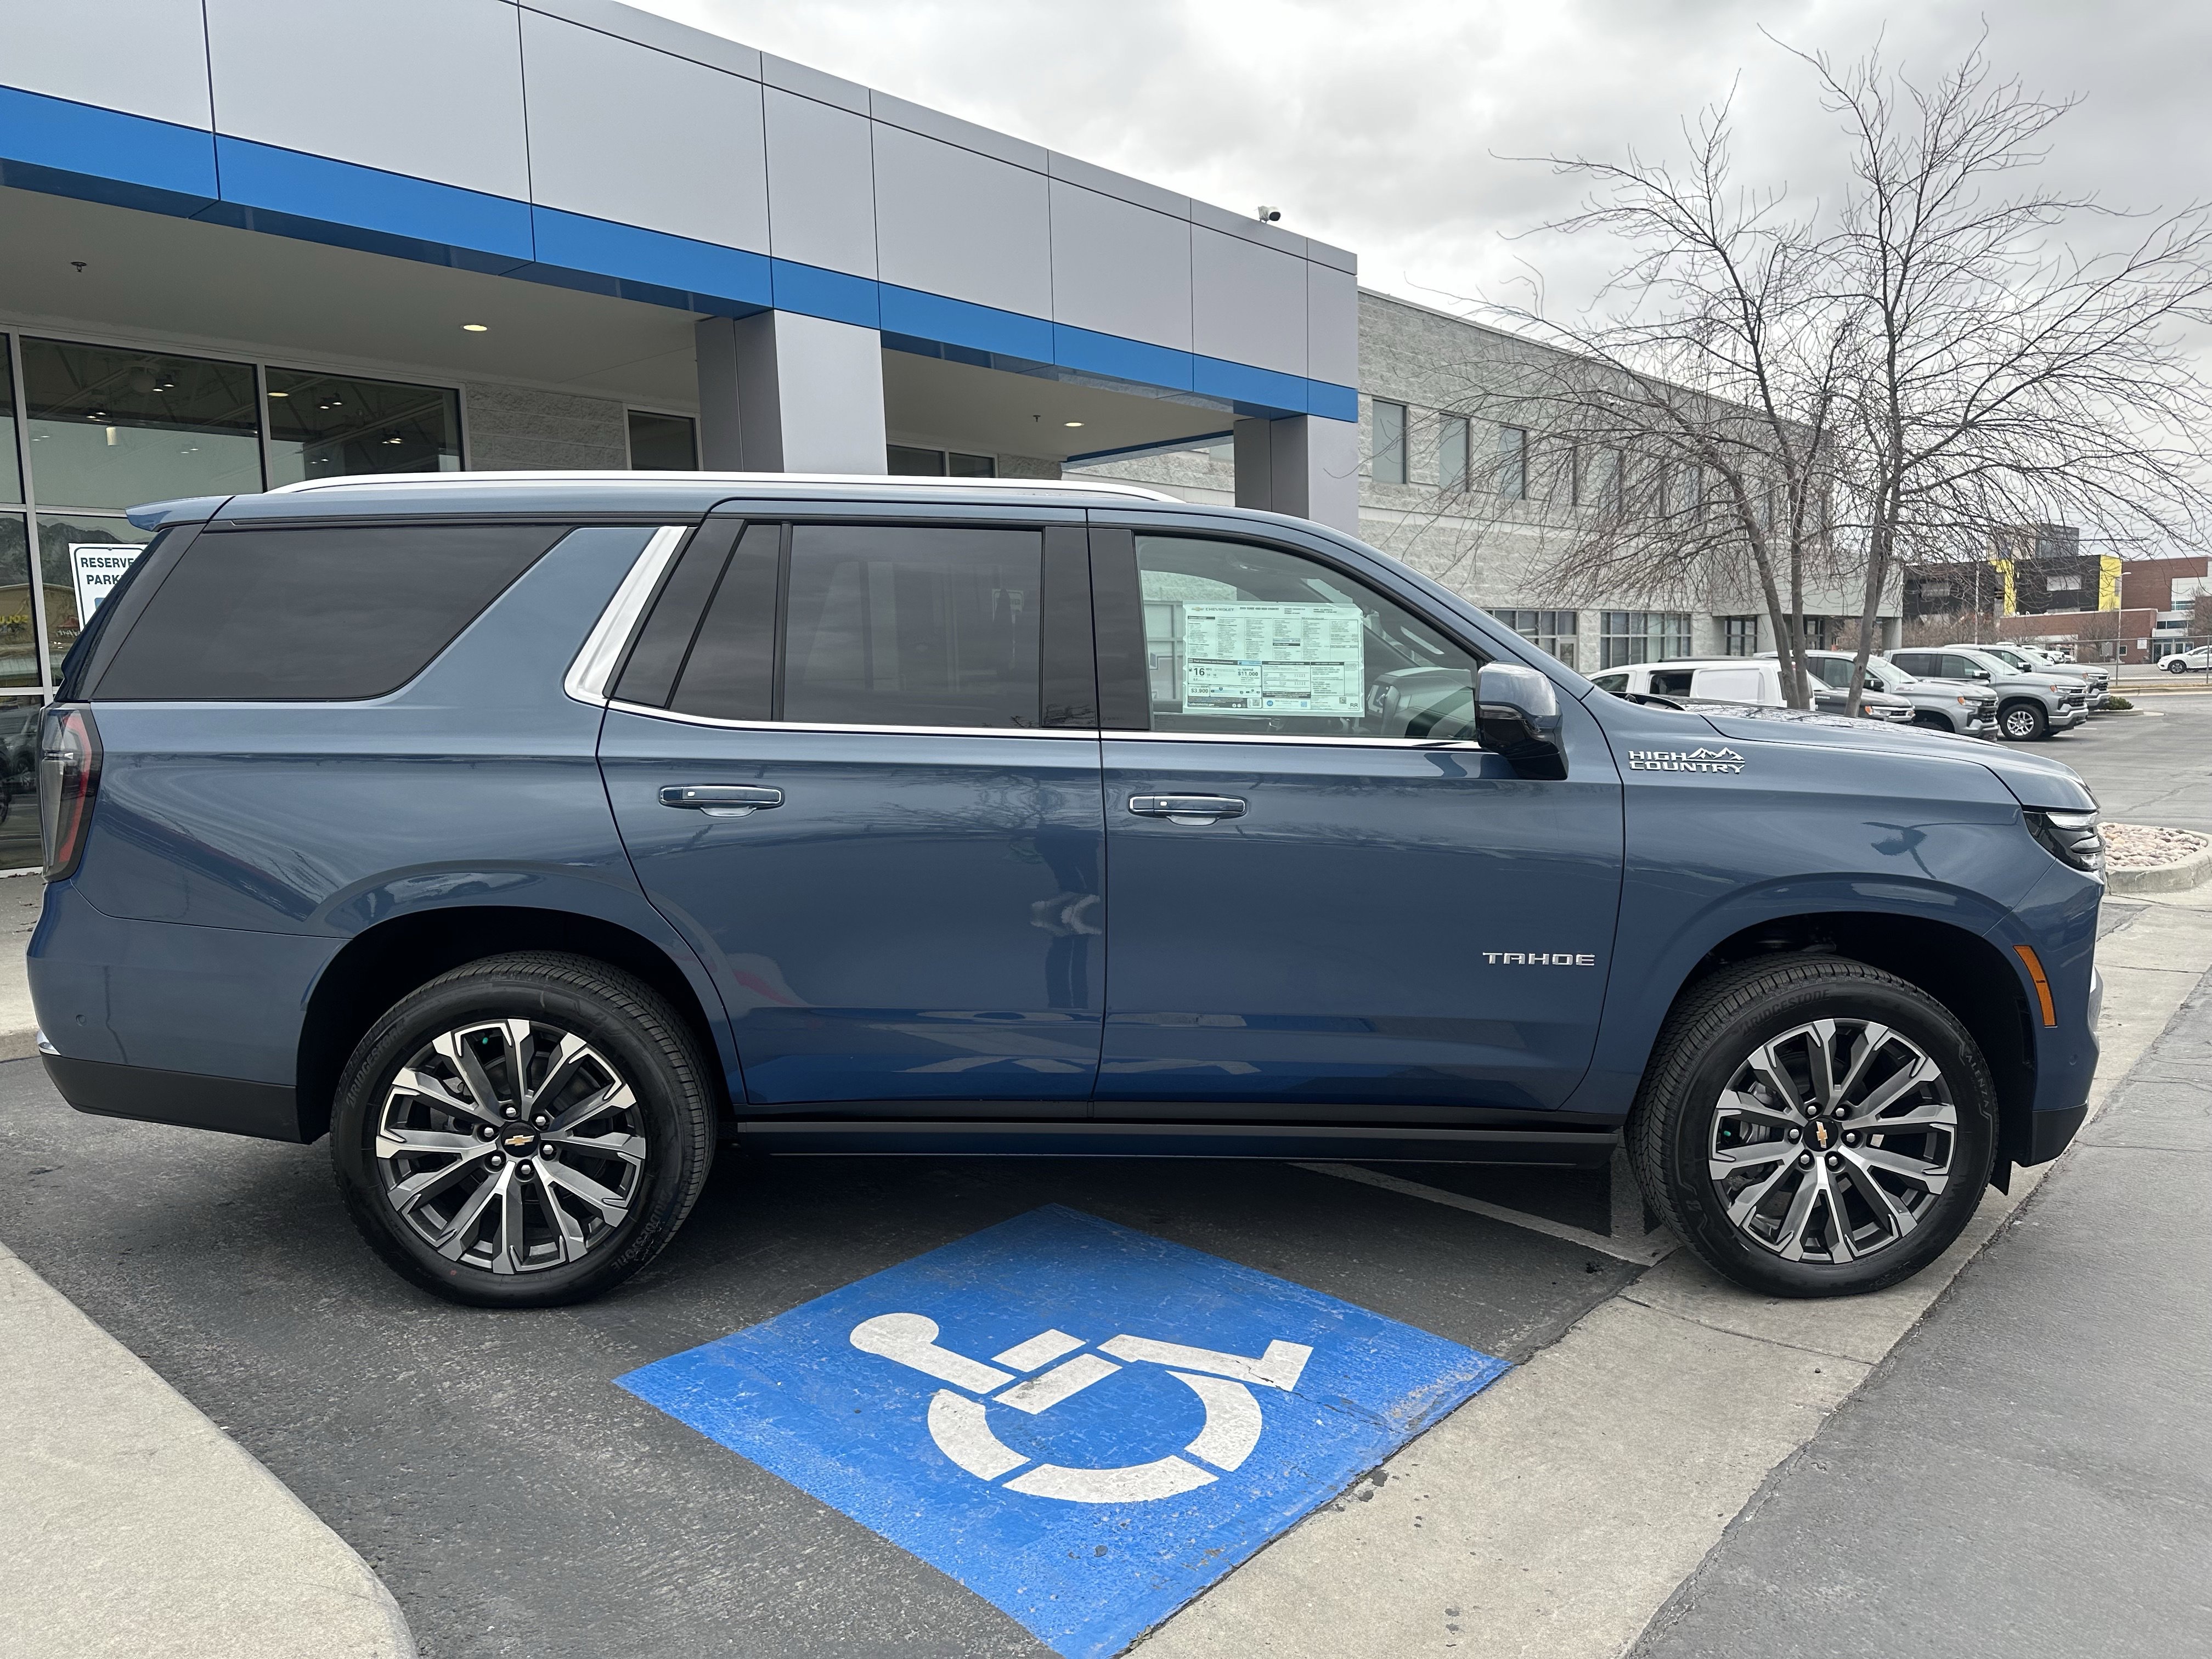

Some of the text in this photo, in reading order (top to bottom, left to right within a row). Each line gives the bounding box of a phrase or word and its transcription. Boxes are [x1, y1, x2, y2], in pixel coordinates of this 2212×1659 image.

[80, 557, 137, 568] RESERVE
[86, 574, 123, 585] PARK
[1193, 668, 1205, 676] 16
[1628, 750, 1686, 761] HIGH
[1629, 760, 1746, 774] COUNTRY
[1482, 952, 1595, 966] TAHOE
[1737, 989, 1831, 1037] BRIDGESTONE
[346, 1018, 405, 1109] BRIDGESTONE
[1966, 1055, 1990, 1108] ALENZA
